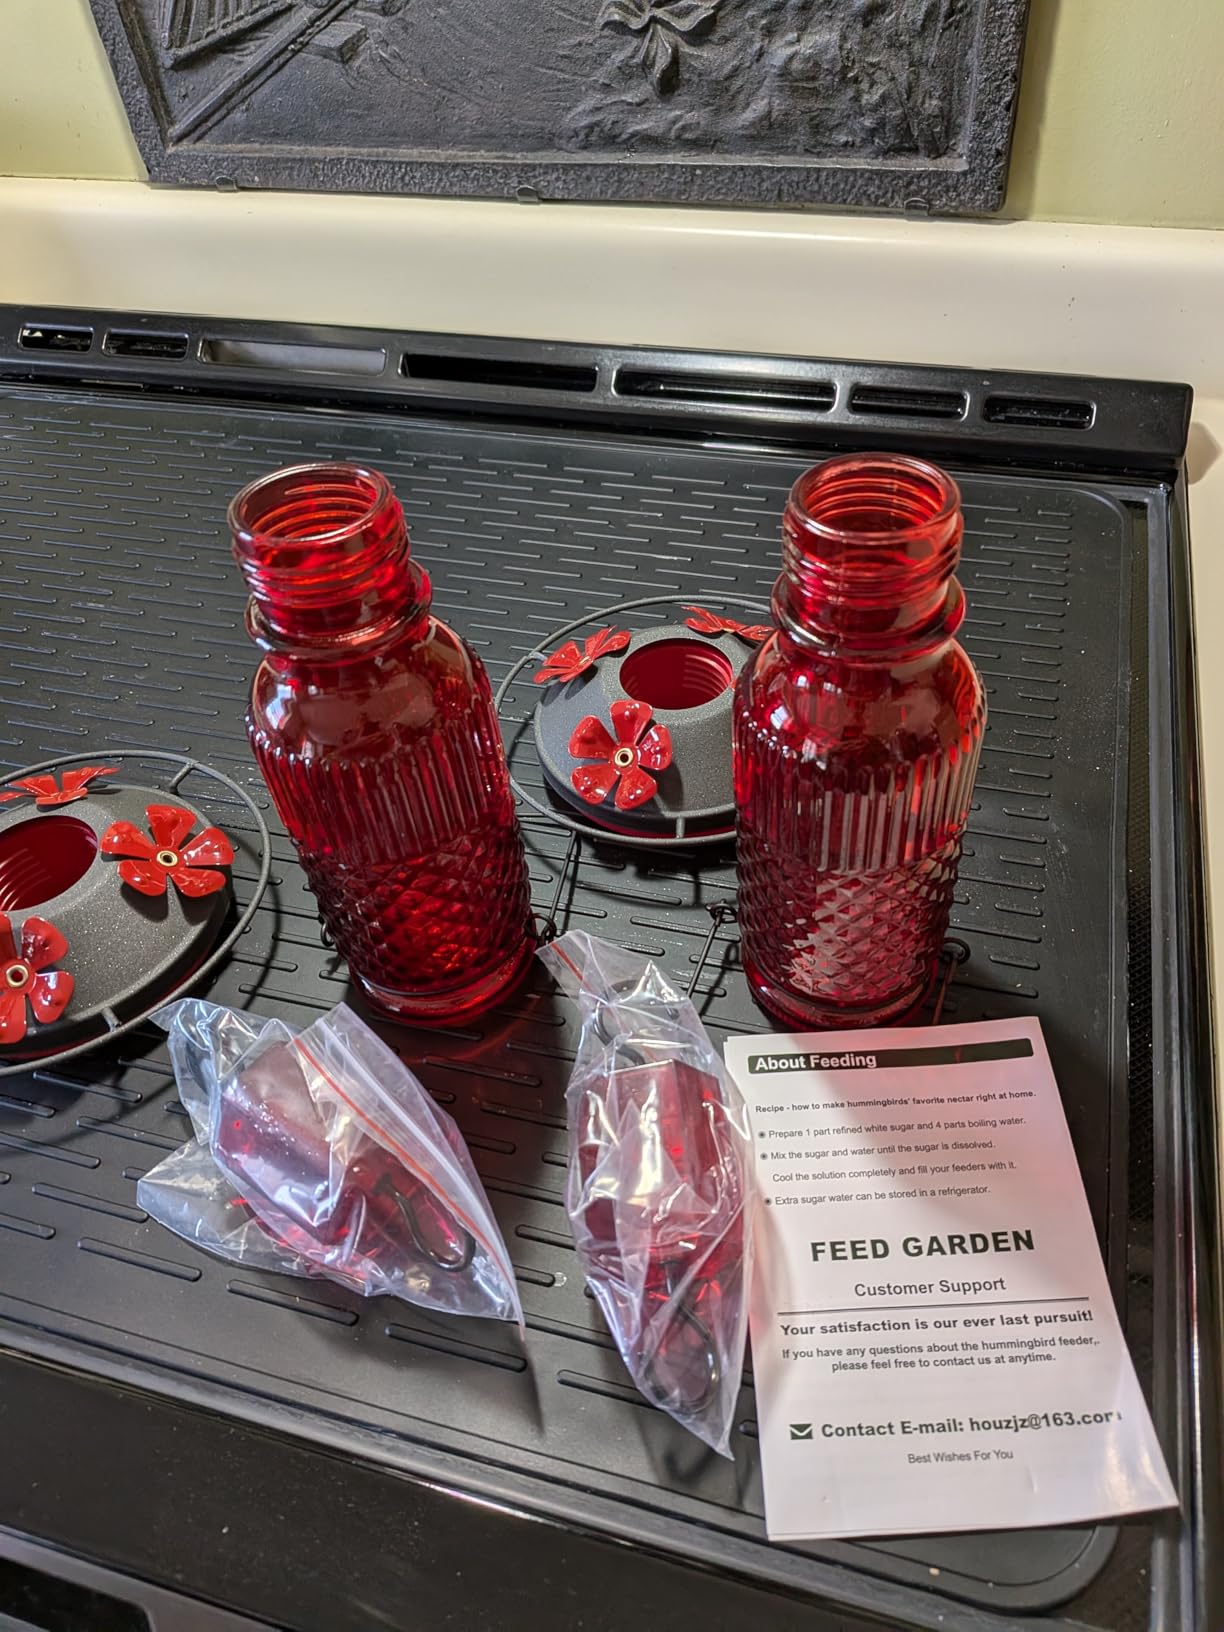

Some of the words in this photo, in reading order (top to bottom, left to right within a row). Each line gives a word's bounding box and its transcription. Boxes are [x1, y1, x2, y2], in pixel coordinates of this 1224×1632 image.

[755, 1056, 806, 1071] About
[810, 1054, 877, 1069] Feeding
[756, 1104, 784, 1113] Recipe
[792, 1103, 809, 1111] how
[823, 1101, 845, 1109] make
[913, 1096, 944, 1105] favorite
[947, 1095, 973, 1104] nectar
[976, 1093, 996, 1102] right
[999, 1092, 1007, 1100] at
[1009, 1091, 1036, 1099] home.
[769, 1129, 803, 1139] Prepare
[805, 1128, 810, 1137] 1
[814, 1128, 830, 1137] part
[832, 1125, 862, 1134] refined
[865, 1124, 887, 1133] white
[890, 1123, 914, 1133] sugar
[917, 1121, 933, 1130] and
[936, 1121, 941, 1129] 4
[944, 1121, 966, 1130] parts
[968, 1119, 997, 1129] boiling
[999, 1117, 1025, 1126] water.
[771, 1151, 786, 1160] Mix
[789, 1151, 802, 1159] the
[805, 1150, 829, 1160] sugar
[832, 1148, 848, 1157] and
[850, 1146, 875, 1156] water
[877, 1144, 895, 1154] until
[898, 1144, 911, 1153] the
[914, 1143, 938, 1153] sugar
[942, 1142, 949, 1151] is
[951, 1140, 995, 1149] dissolved.
[773, 1173, 793, 1182] Cool
[796, 1173, 809, 1181] the
[812, 1171, 846, 1180] solution
[849, 1167, 896, 1177] completely
[899, 1166, 915, 1175] and
[918, 1165, 927, 1174] fill
[930, 1166, 949, 1175] your
[952, 1162, 986, 1172] feeders
[988, 1161, 1006, 1170] with
[1008, 1161, 1016, 1169] it.
[775, 1196, 798, 1206] Extra
[801, 1196, 826, 1205] sugar
[828, 1193, 853, 1202] water
[856, 1193, 872, 1201] can
[875, 1191, 886, 1200] be
[889, 1189, 917, 1198] stored
[919, 1188, 928, 1197] in
[930, 1189, 936, 1197] a
[939, 1186, 990, 1196] refrigerator.
[811, 1239, 889, 1261] FEED
[903, 1230, 1034, 1256] GARDEN
[855, 1283, 934, 1296] Customer
[940, 1278, 1006, 1295] Support
[781, 1325, 815, 1335] Your
[821, 1320, 910, 1333] satisfaction
[915, 1319, 928, 1329] is
[934, 1319, 958, 1329] our
[963, 1318, 995, 1327] ever
[1000, 1314, 1029, 1325] last
[1034, 1310, 1093, 1326] pursuit!
[783, 1349, 789, 1358] If
[790, 1350, 812, 1360] you
[816, 1347, 842, 1357] have
[847, 1348, 865, 1357] any
[869, 1344, 923, 1356] questions
[927, 1343, 958, 1352] about
[961, 1342, 978, 1351] the
[982, 1337, 1056, 1350] hummingbird
[832, 1361, 868, 1373] please
[871, 1359, 891, 1369] feel
[894, 1359, 915, 1368] free
[919, 1358, 930, 1368] to
[933, 1357, 974, 1366] contact
[978, 1356, 991, 1365] us
[995, 1354, 1005, 1364] at
[1008, 1351, 1056, 1364] anytime.
[822, 1423, 894, 1437] Contact
[901, 1419, 963, 1434] E-mail:
[908, 1454, 931, 1463] Best
[933, 1453, 971, 1462] Wishes
[974, 1451, 990, 1460] For
[993, 1450, 1013, 1459] You
